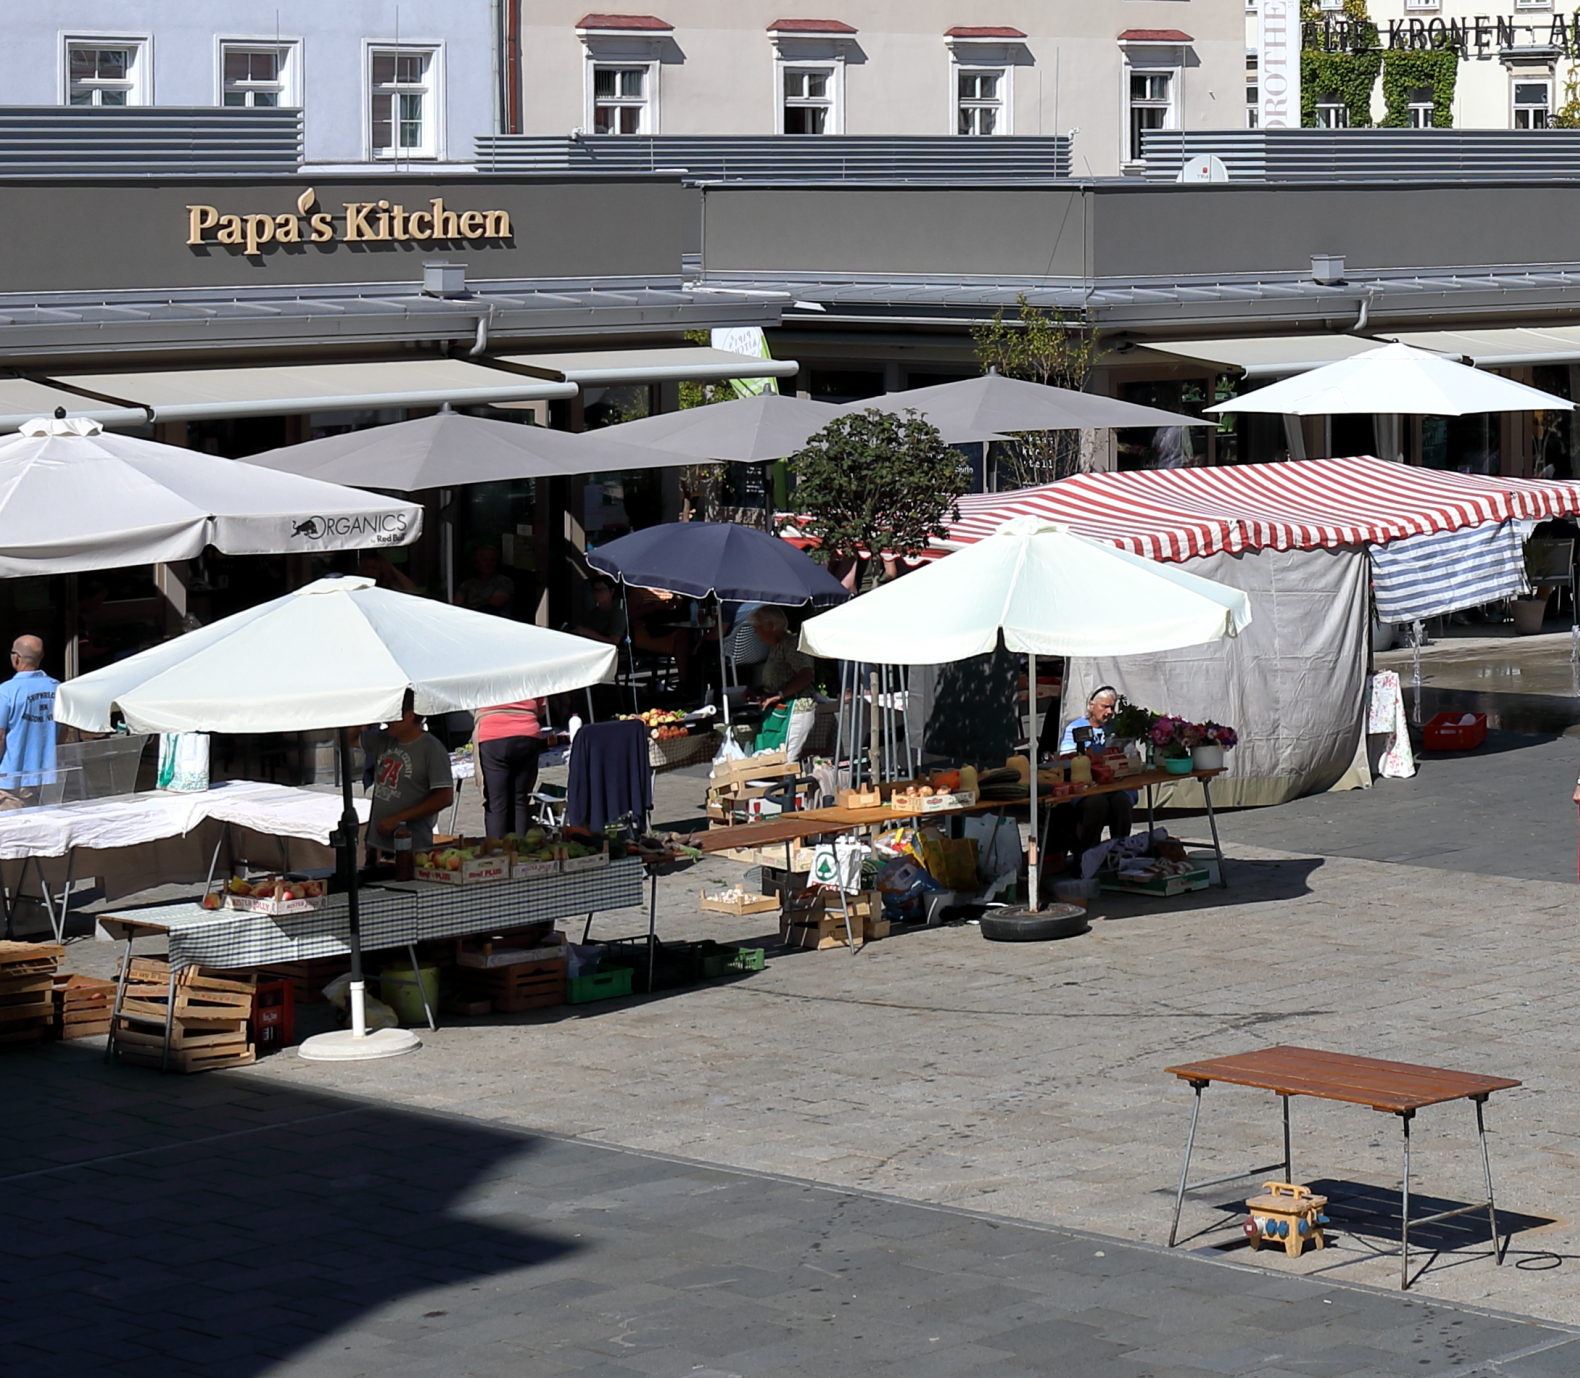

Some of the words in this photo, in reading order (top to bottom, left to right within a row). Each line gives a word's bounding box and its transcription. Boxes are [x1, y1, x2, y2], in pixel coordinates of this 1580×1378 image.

[1387, 15, 1514, 49] KRONEN
[186, 188, 333, 255] Papa's
[342, 198, 513, 241] Kitchen
[308, 514, 407, 540] ORGANICS
[377, 534, 392, 543] Red
